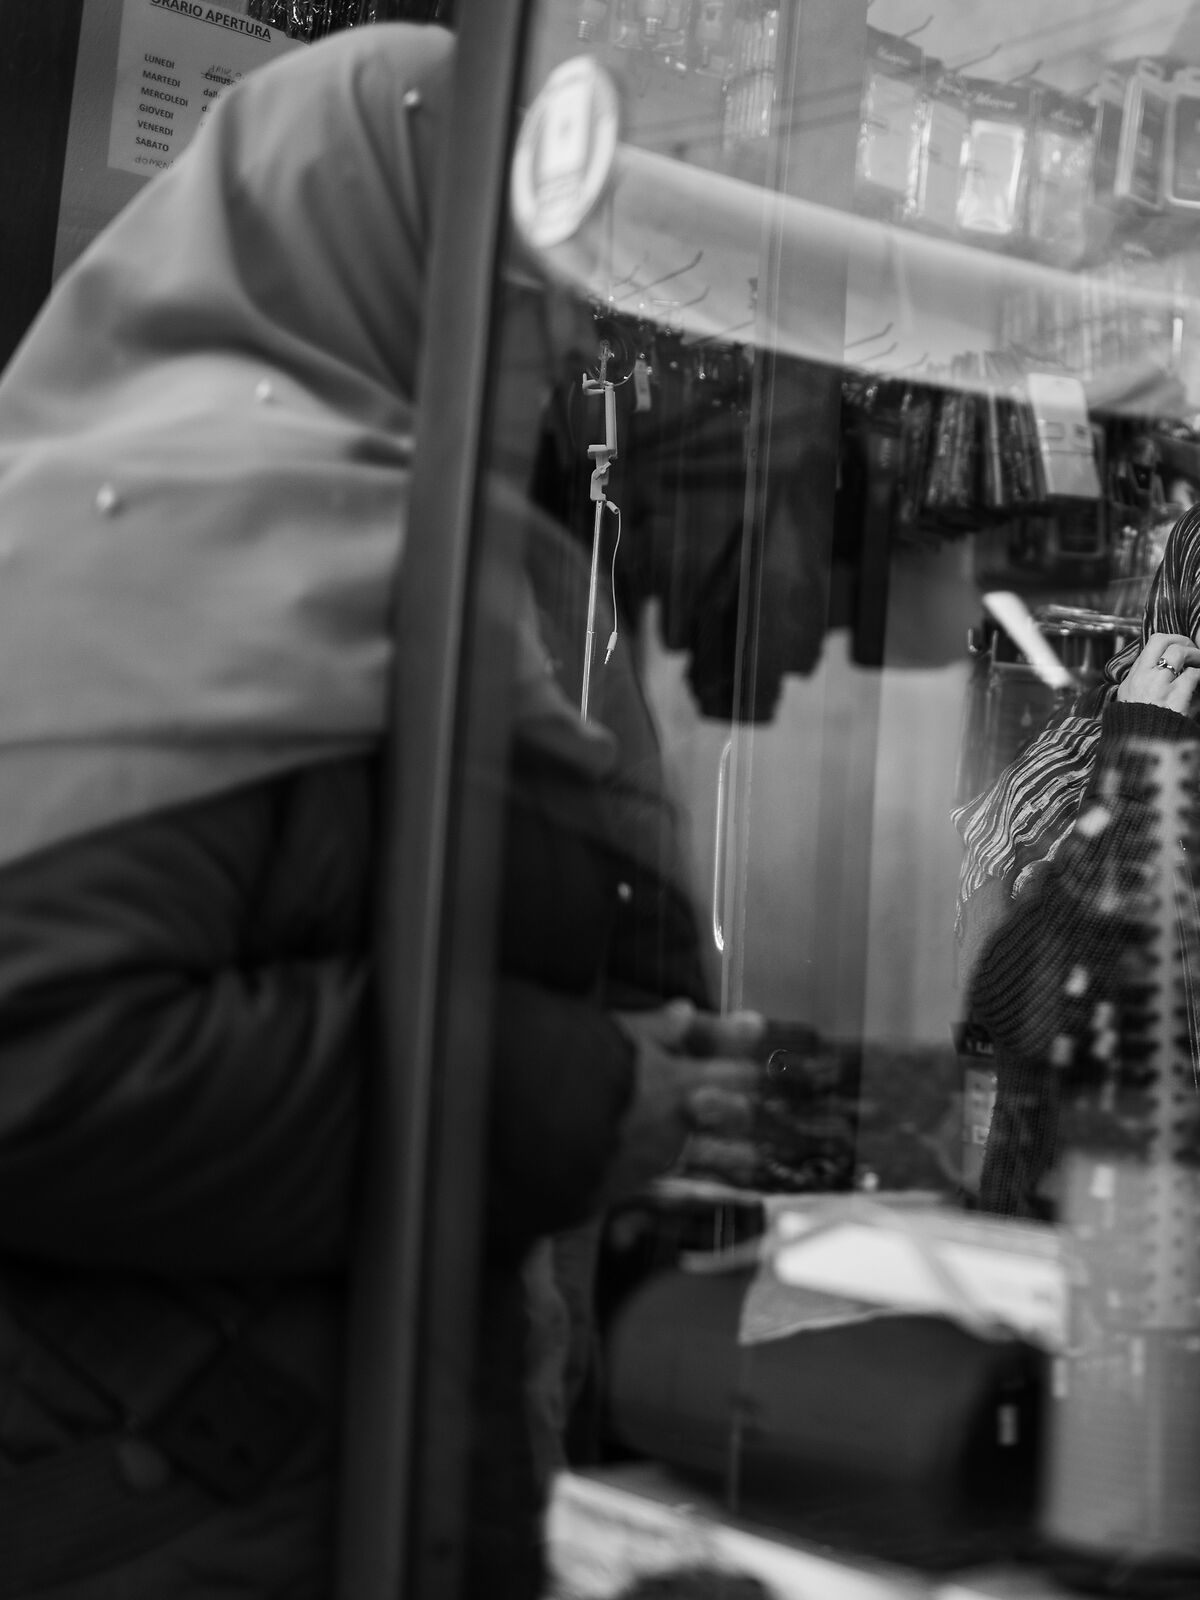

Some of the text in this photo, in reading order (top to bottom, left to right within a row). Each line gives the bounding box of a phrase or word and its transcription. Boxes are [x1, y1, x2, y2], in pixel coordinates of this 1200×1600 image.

[204, 9, 272, 40] APERTURA
[144, 53, 175, 69] LUNEDI
[142, 70, 181, 88] MARTEDI
[140, 86, 188, 107] MERCOLEDI
[138, 103, 174, 120] GIOVEDI
[137, 119, 173, 136] VENERDI
[135, 136, 169, 152] SABATO
